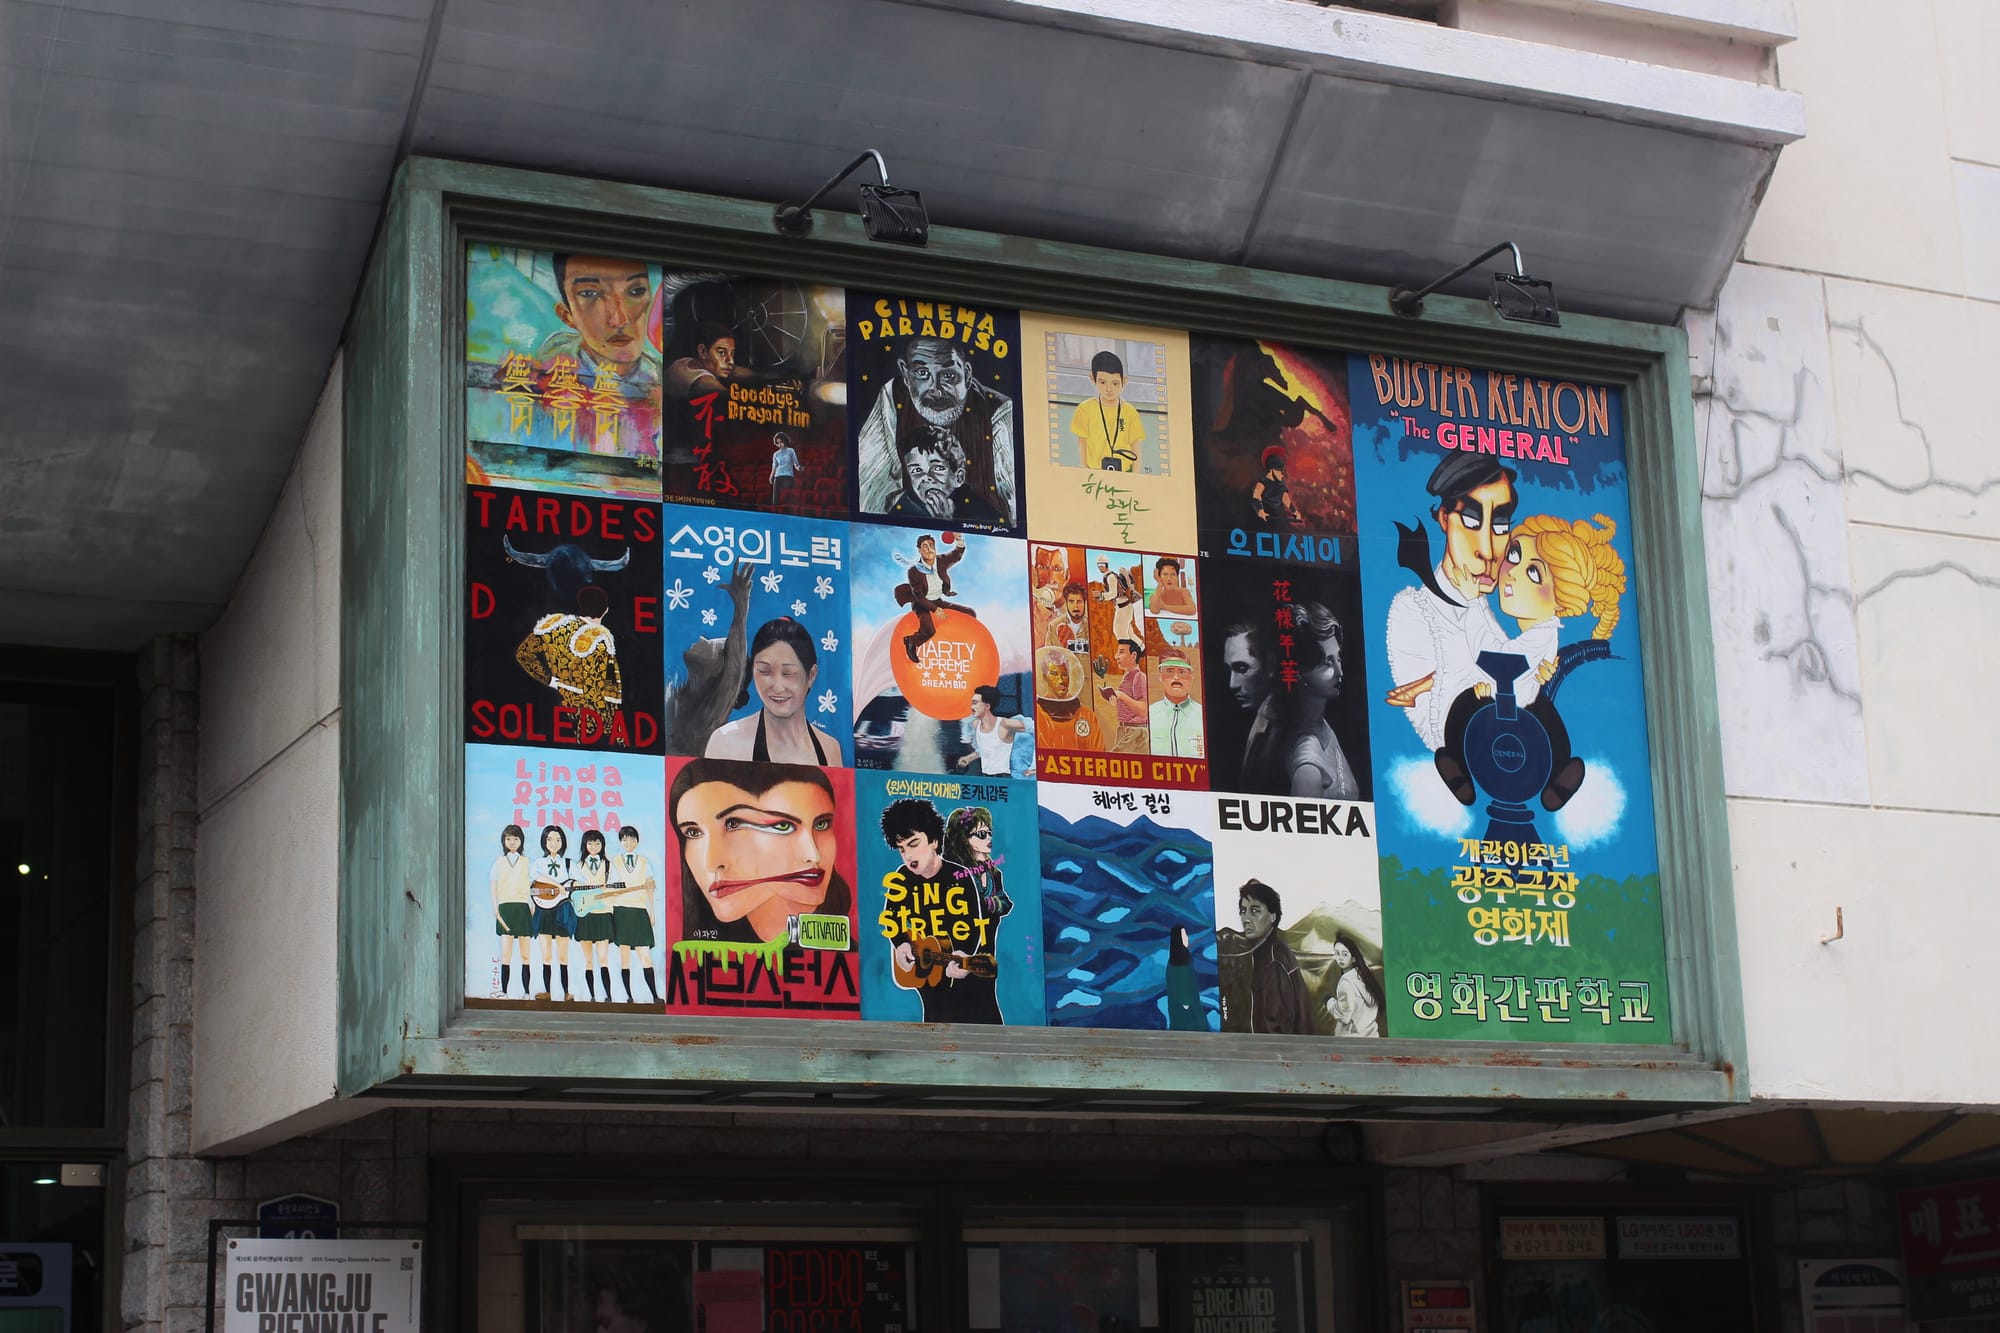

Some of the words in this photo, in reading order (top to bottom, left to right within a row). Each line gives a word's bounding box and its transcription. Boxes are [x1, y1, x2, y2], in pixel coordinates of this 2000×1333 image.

[874, 299, 995, 336] CINEMA
[858, 318, 1009, 360] PARADISO
[727, 400, 783, 425] Dragon
[787, 406, 811, 428] Inn
[729, 382, 800, 409] Goodbye,
[1368, 353, 1480, 418] BUSTER
[1488, 372, 1609, 437] KEATON
[1081, 473, 1133, 501] 하나
[473, 491, 656, 543] TARDES
[669, 524, 771, 568] 소영의
[779, 532, 842, 571] 노력
[1226, 528, 1342, 565] 오디세이
[916, 657, 971, 673] SUPREME
[471, 699, 658, 748] SOLEDAD
[515, 758, 624, 788] Linda
[1092, 790, 1139, 812] 헤어질
[1143, 791, 1171, 815] 결심
[1218, 798, 1371, 838] EUREKA
[1451, 865, 1580, 909] 광주극장
[801, 919, 849, 943] ACTIVATOR
[1467, 906, 1572, 948] 영화제
[666, 947, 861, 1012] 서브스턴스
[1406, 971, 1655, 1026] 영화간판학교
[236, 1273, 373, 1313] GWANGJU
[768, 1249, 865, 1308] PEDRO
[1205, 1287, 1275, 1316] DREAMED
